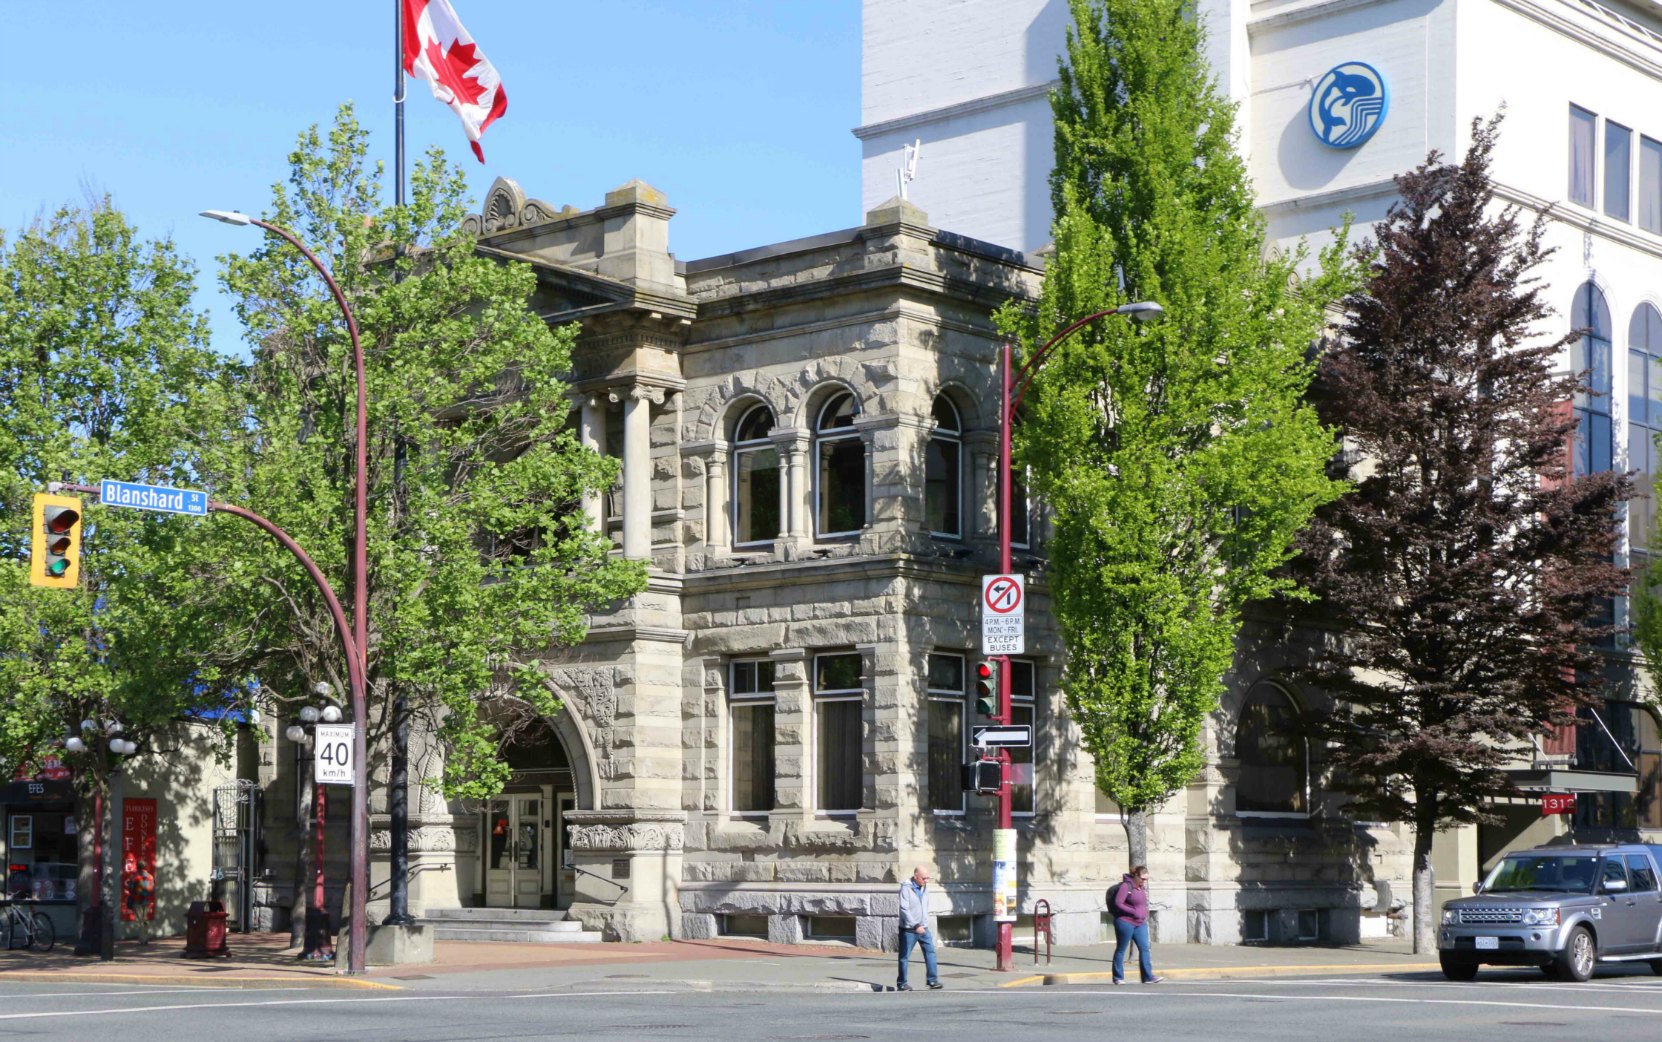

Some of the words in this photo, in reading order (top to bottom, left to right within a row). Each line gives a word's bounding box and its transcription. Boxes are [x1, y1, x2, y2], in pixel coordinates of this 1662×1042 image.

[106, 484, 183, 509] Blanshard
[191, 494, 199, 502] St
[188, 504, 202, 512] 1300
[988, 635, 1019, 643] EXCEPT
[320, 742, 349, 766] 40
[322, 769, 346, 777] km/h
[28, 783, 45, 794] EFES
[1543, 799, 1574, 808] 1312
